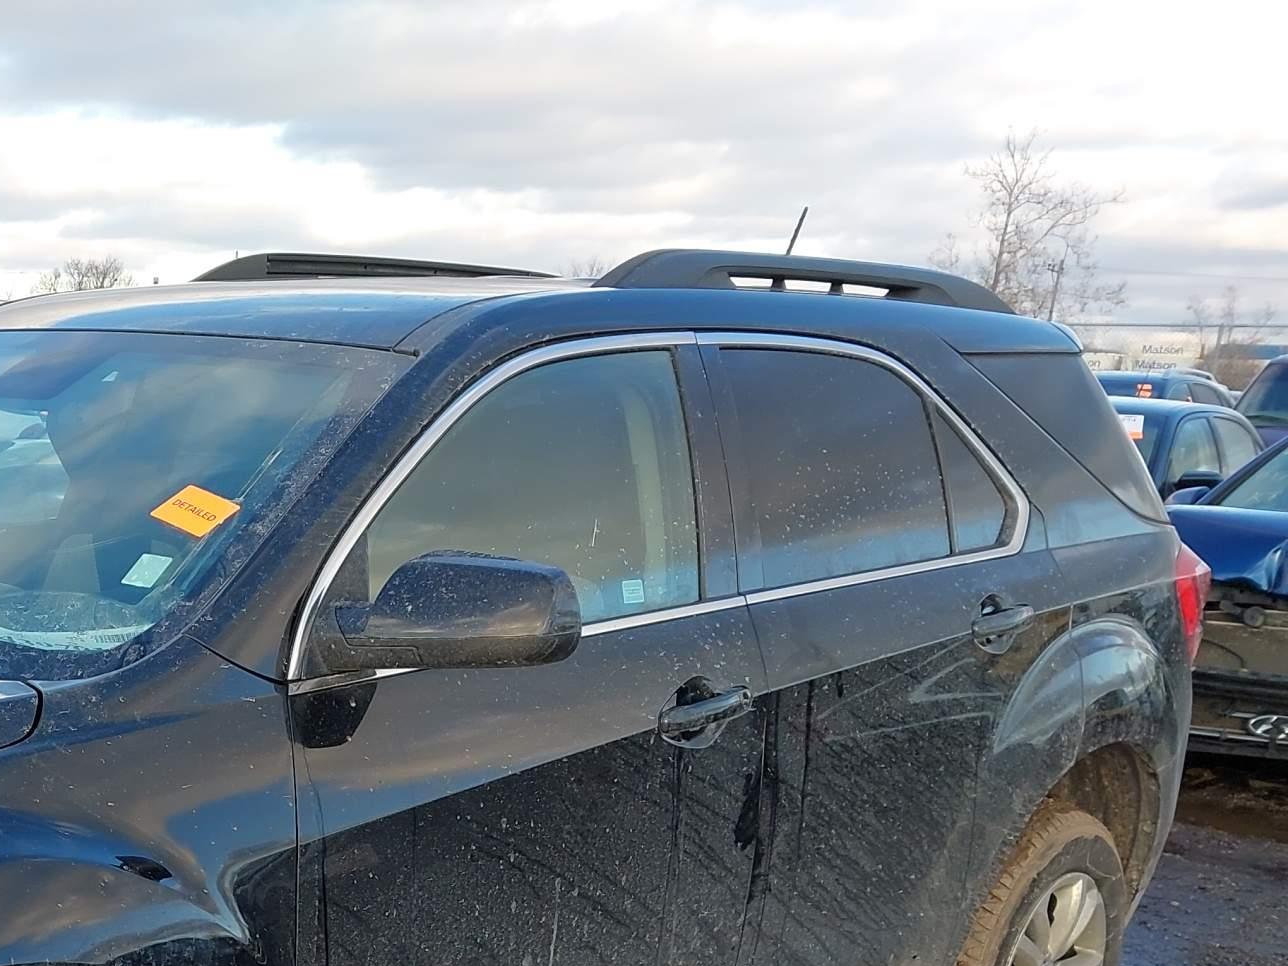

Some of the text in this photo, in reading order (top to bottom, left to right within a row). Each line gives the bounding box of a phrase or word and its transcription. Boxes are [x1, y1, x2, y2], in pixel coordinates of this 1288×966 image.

[1142, 344, 1184, 355] Matson
[1135, 359, 1177, 370] Matson
[172, 499, 217, 522] DETAILED
